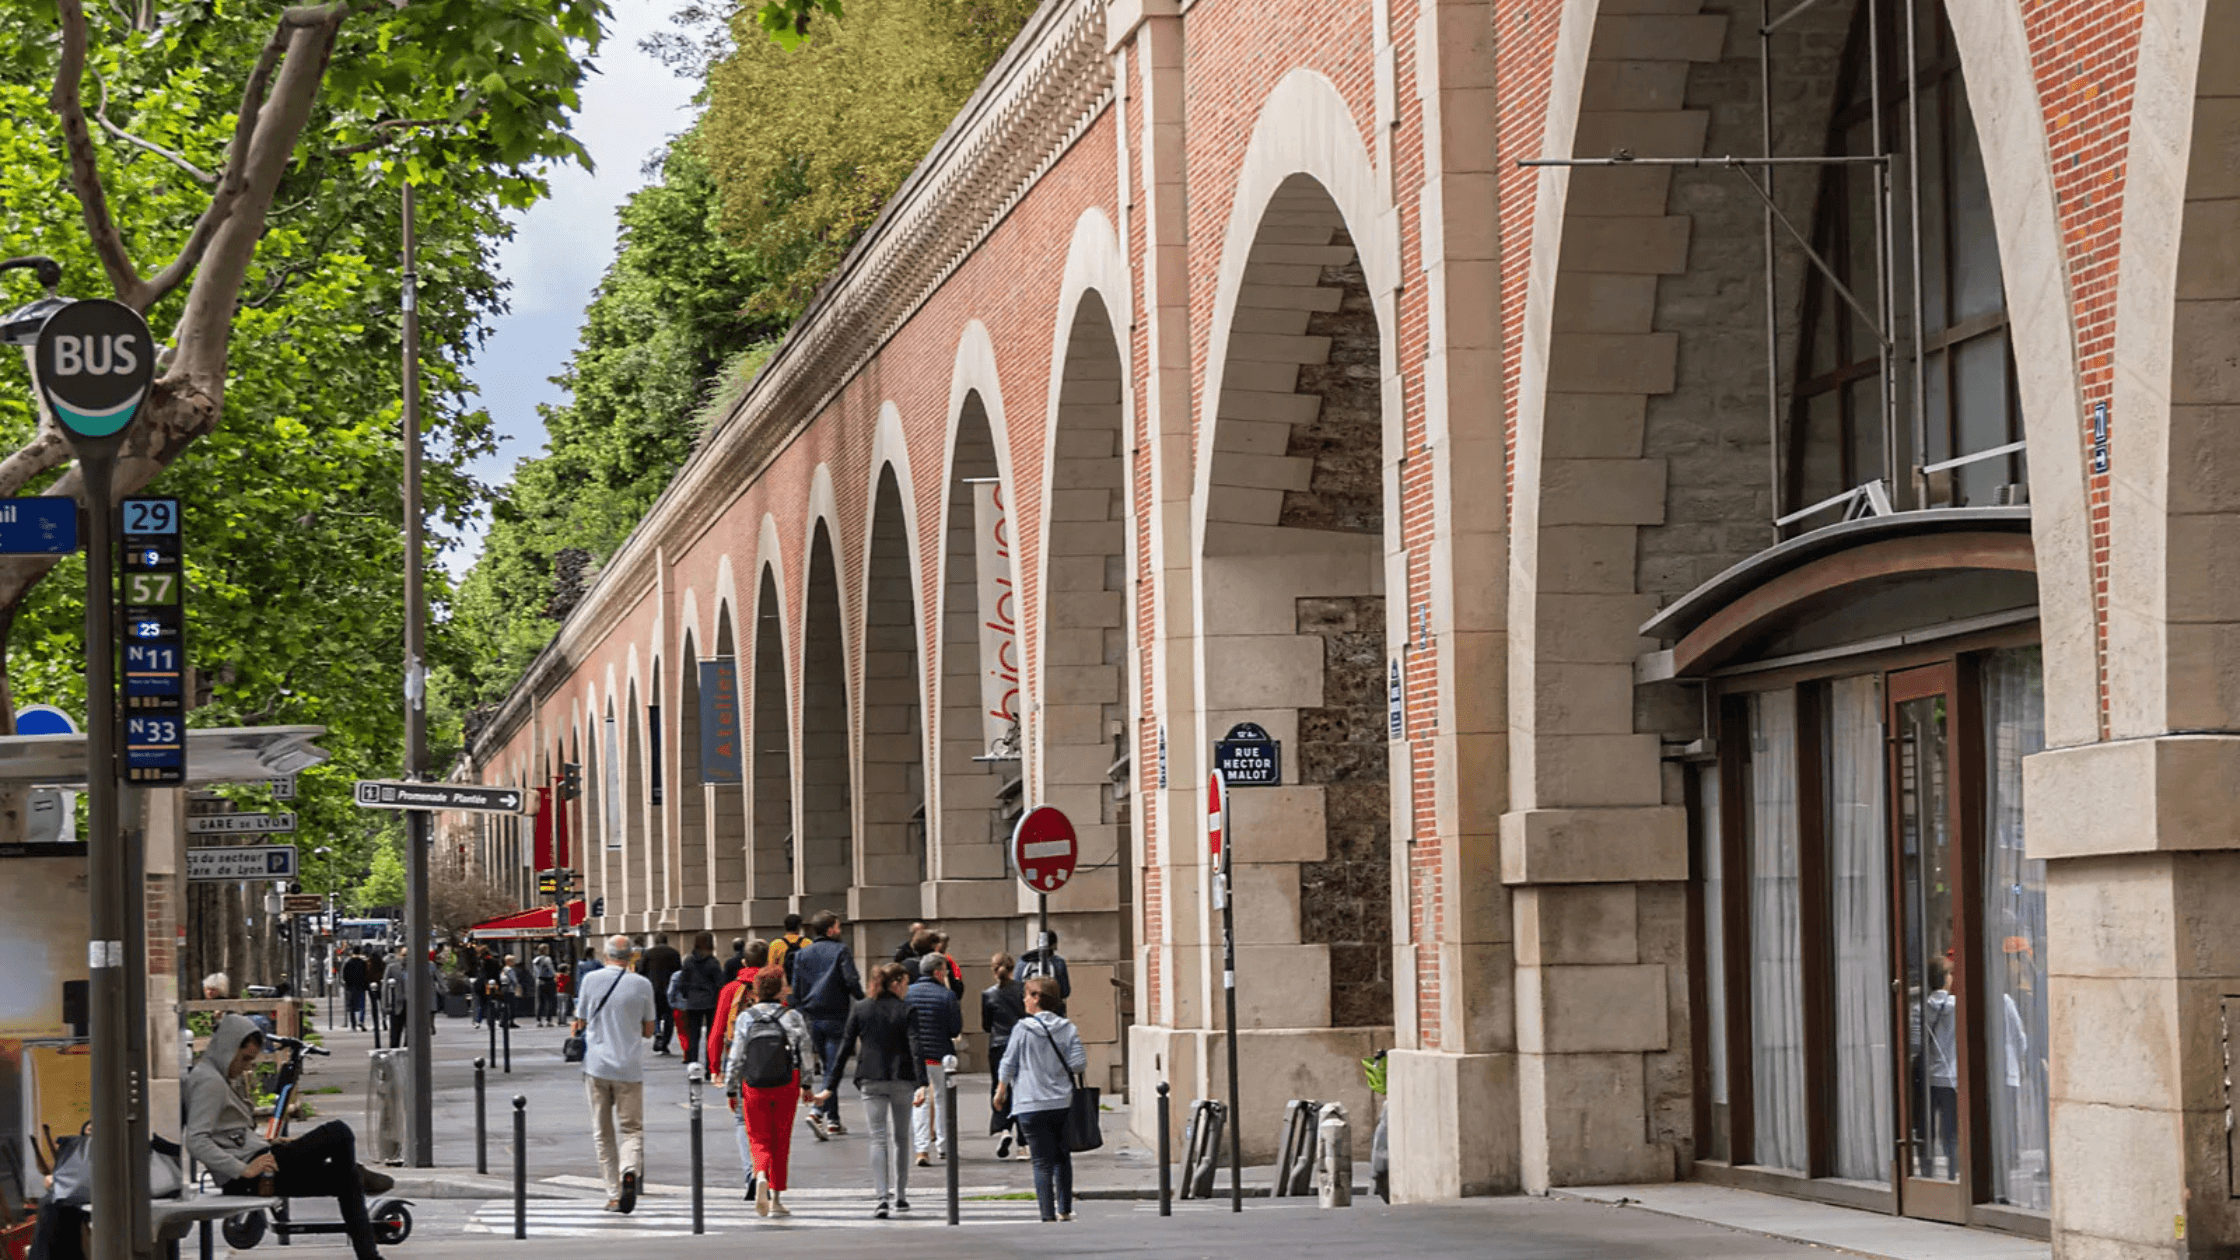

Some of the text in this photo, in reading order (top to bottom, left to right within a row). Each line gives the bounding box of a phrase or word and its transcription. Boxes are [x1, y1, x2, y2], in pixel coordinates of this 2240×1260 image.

[55, 334, 137, 376] BUS
[130, 503, 171, 530] 29
[149, 552, 160, 566] 9
[132, 575, 172, 603] 57
[986, 484, 1019, 721] biclo
[140, 623, 161, 637] 25
[128, 646, 174, 670] N11
[129, 718, 176, 743] N33
[1235, 747, 1260, 757] RUE
[1223, 758, 1271, 769] HECTOR
[1227, 769, 1268, 780] MALOT
[200, 818, 233, 829] GARE
[257, 817, 289, 828] LYON
[201, 853, 214, 863] du
[219, 853, 263, 862] secteur
[272, 855, 284, 870] P
[218, 865, 231, 875] de
[238, 864, 263, 876] Lyon
